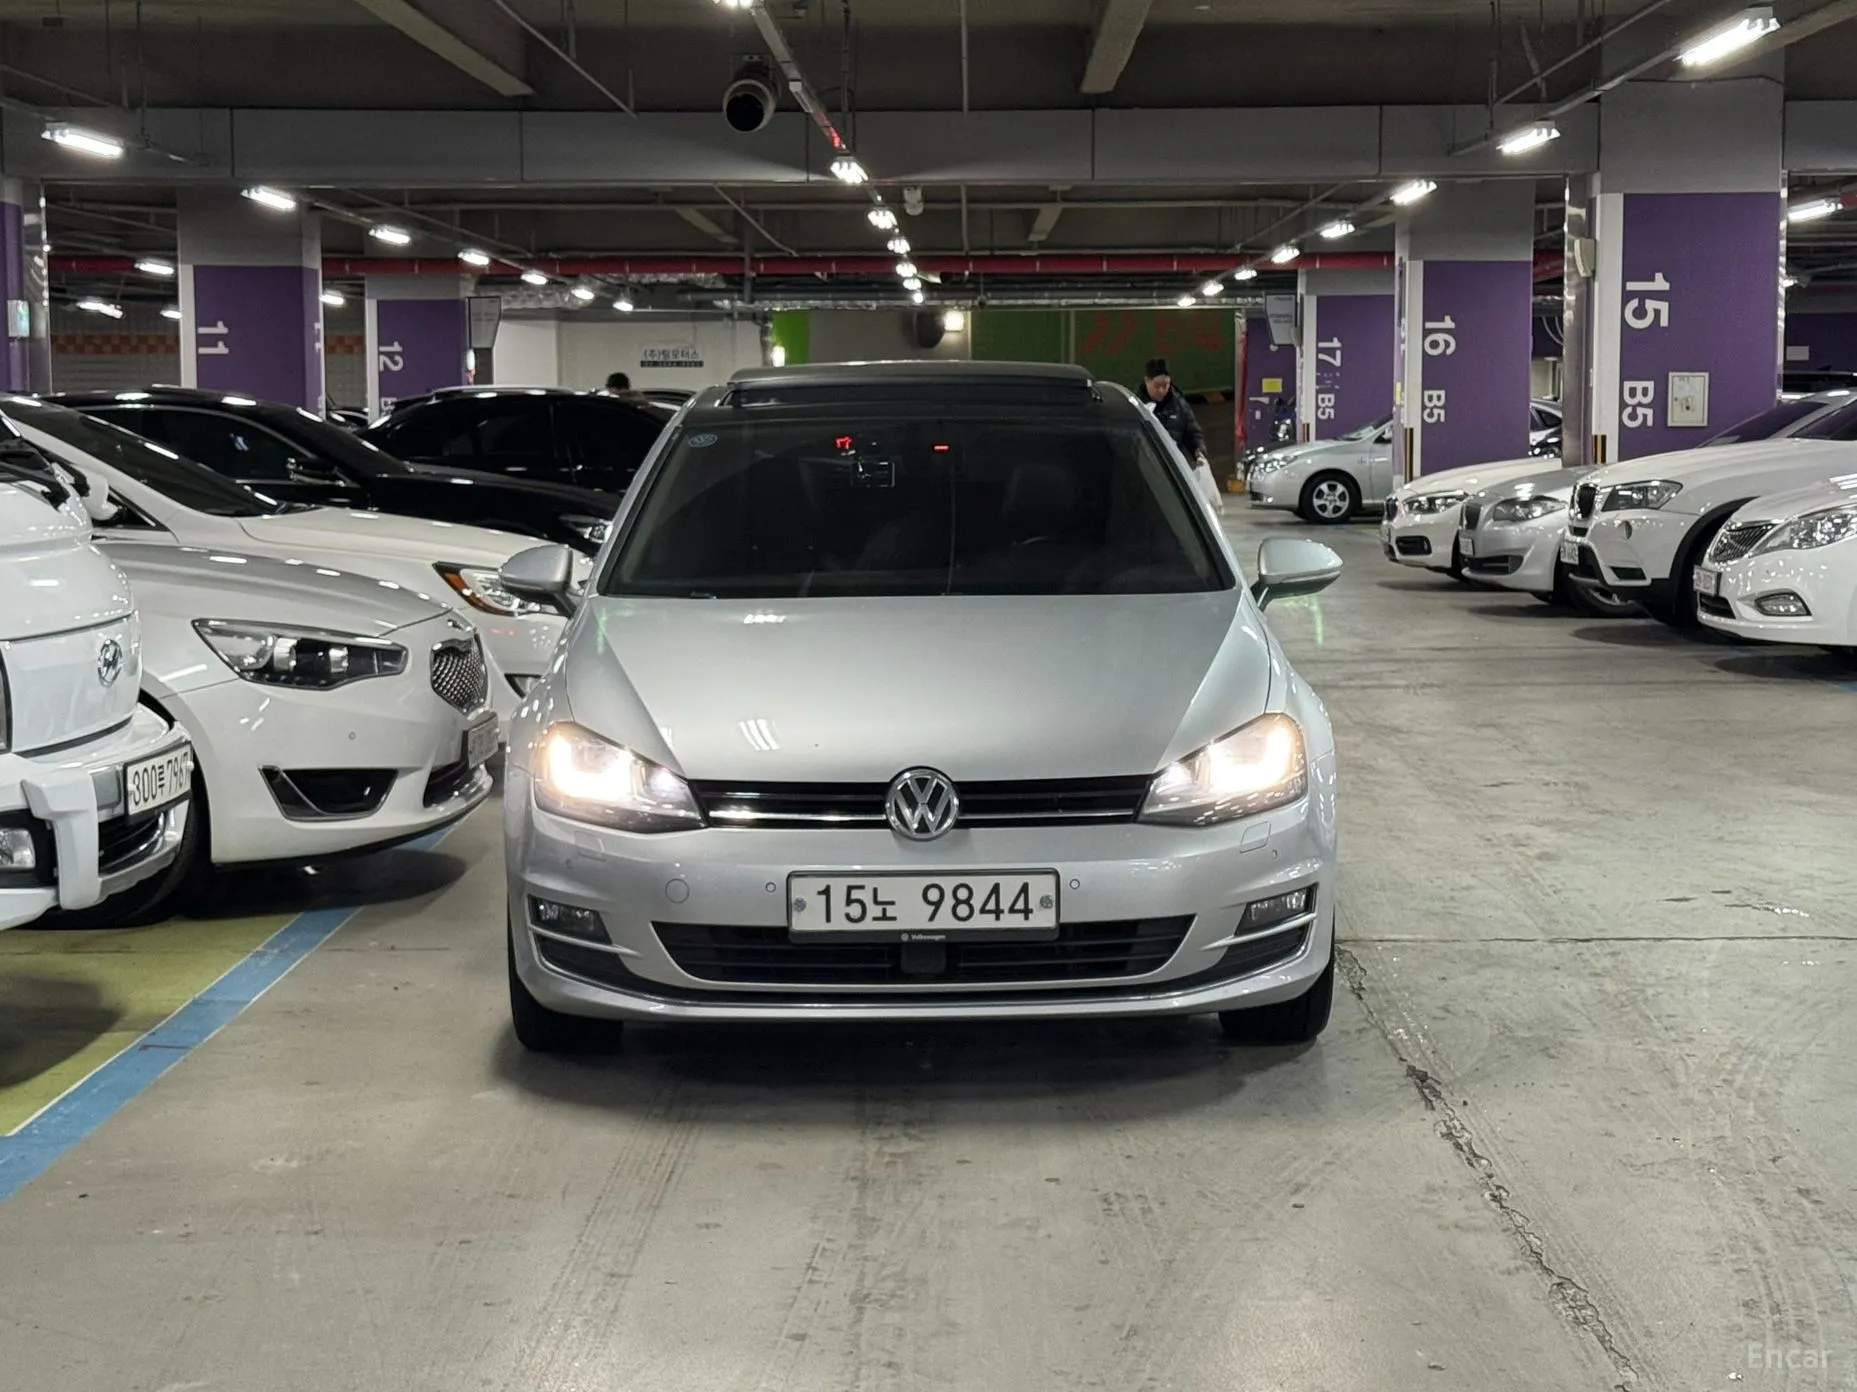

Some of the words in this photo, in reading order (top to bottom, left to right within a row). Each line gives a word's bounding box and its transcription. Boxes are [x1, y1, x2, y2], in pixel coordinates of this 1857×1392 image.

[1624, 272, 1670, 329] 15
[197, 321, 229, 354] 11
[1317, 337, 1342, 368] 17
[1423, 315, 1457, 356] 16
[379, 341, 404, 372] 12
[1317, 393, 1335, 420] B5
[1423, 389, 1446, 424] B5
[1622, 381, 1655, 428] B5
[816, 884, 898, 924] 15노
[922, 882, 1034, 922] 9844
